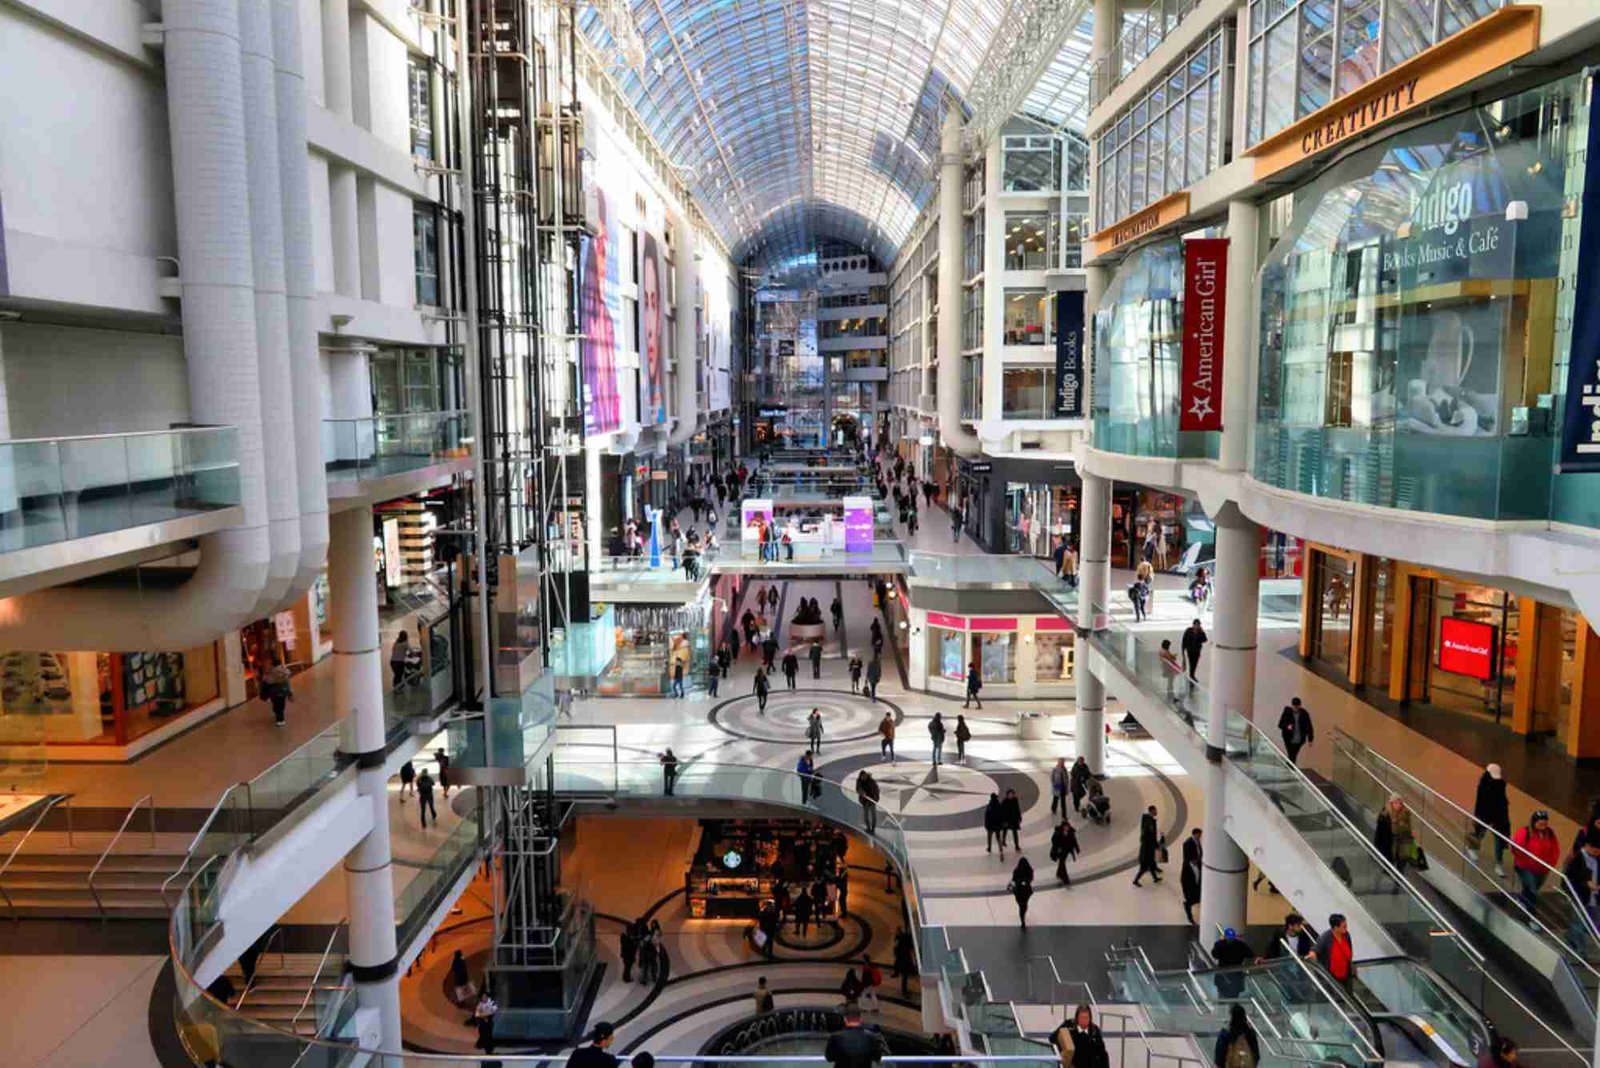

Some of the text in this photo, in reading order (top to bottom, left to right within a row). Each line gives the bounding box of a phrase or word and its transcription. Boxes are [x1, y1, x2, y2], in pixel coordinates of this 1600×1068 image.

[1302, 77, 1419, 154] CREATIVITY
[1418, 241, 1454, 265] Music
[1456, 238, 1468, 258] &
[1469, 227, 1499, 254] Café
[1059, 331, 1079, 411] Indigo Books
